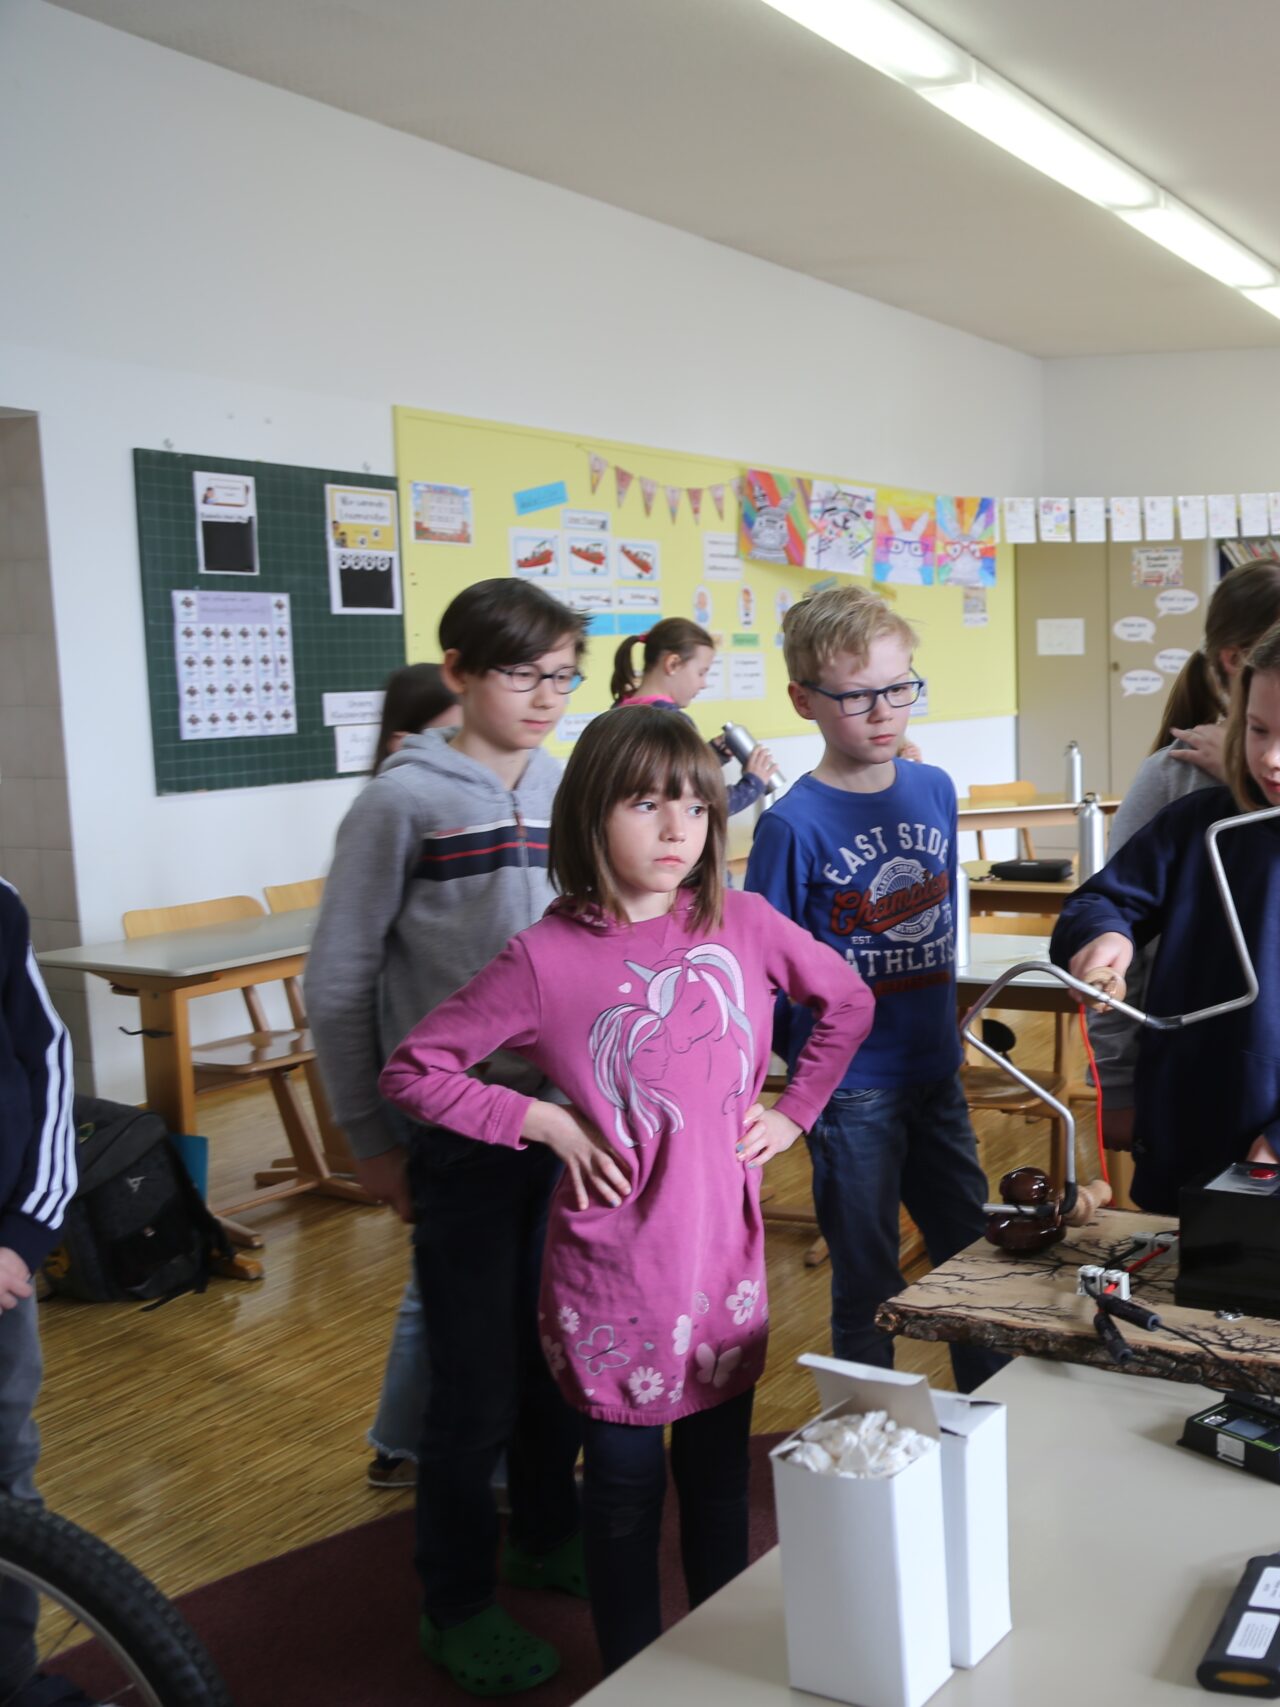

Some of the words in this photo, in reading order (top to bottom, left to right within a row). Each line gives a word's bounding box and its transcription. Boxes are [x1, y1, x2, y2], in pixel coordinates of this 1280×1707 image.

[823, 826, 888, 886] EAST
[897, 822, 949, 864] SIDE
[851, 935, 875, 945] EST.
